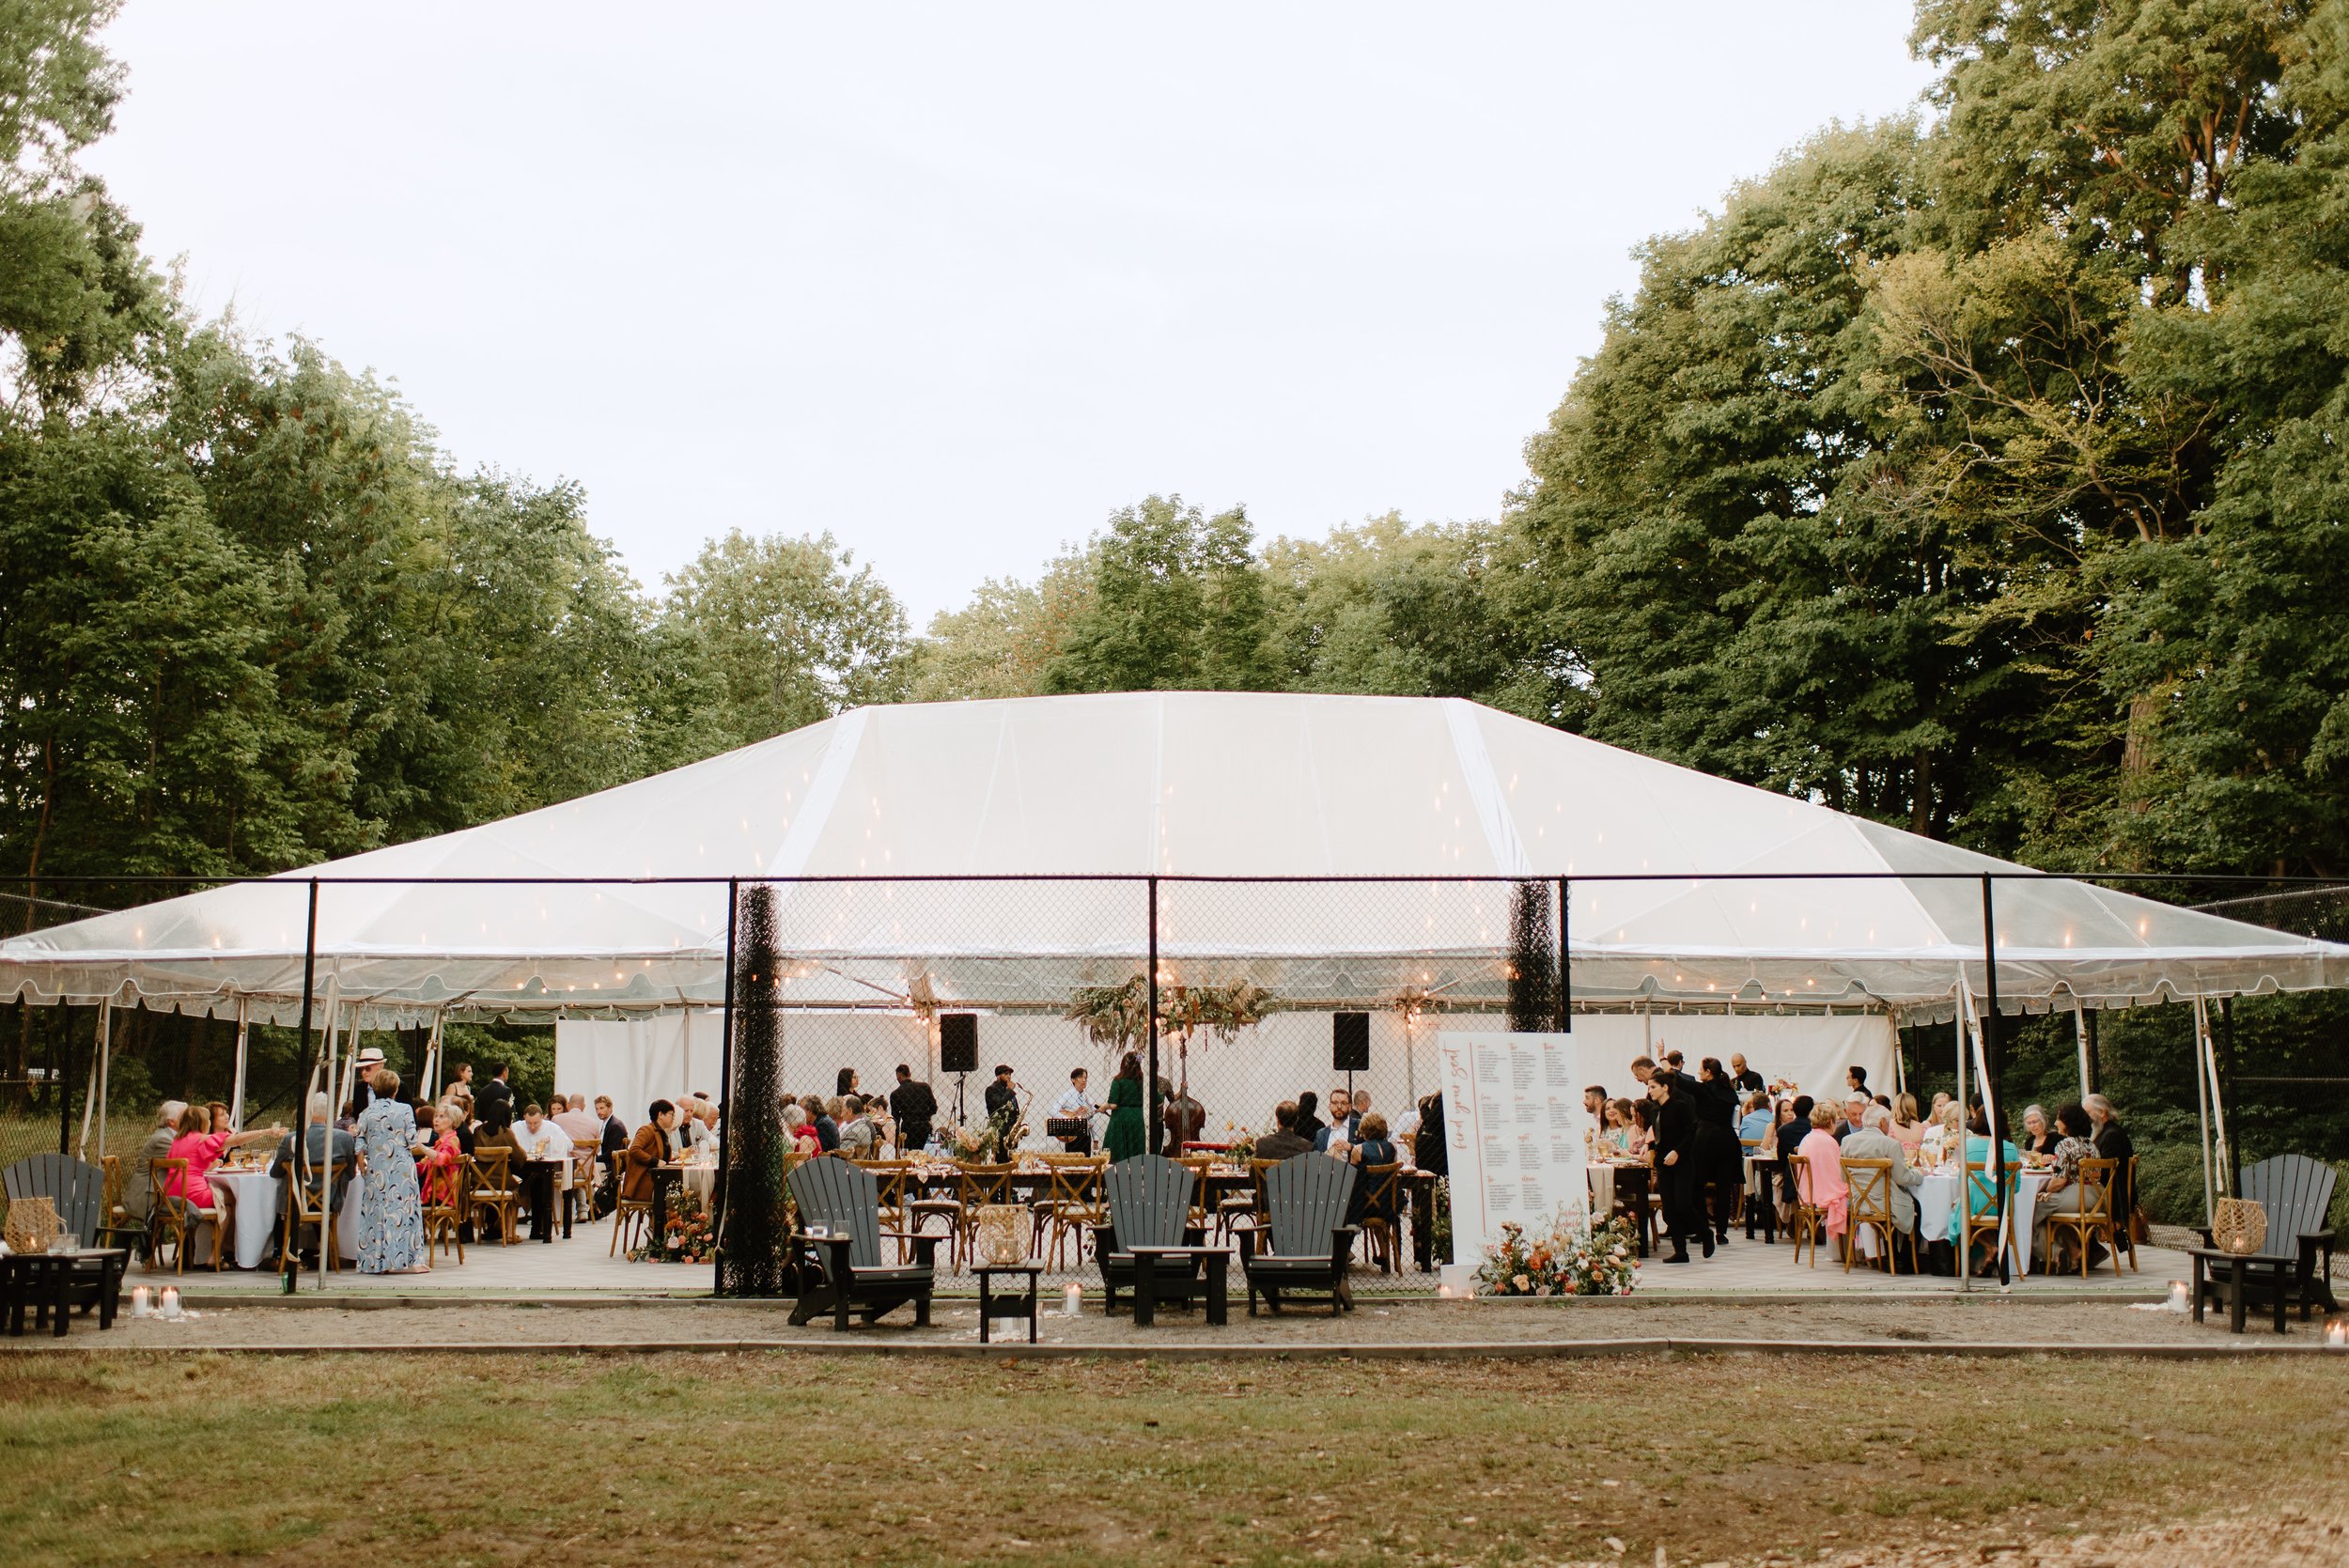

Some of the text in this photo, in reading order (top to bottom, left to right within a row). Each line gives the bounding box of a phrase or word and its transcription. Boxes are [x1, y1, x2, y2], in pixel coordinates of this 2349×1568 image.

[1441, 1039, 1471, 1150] find your seat
